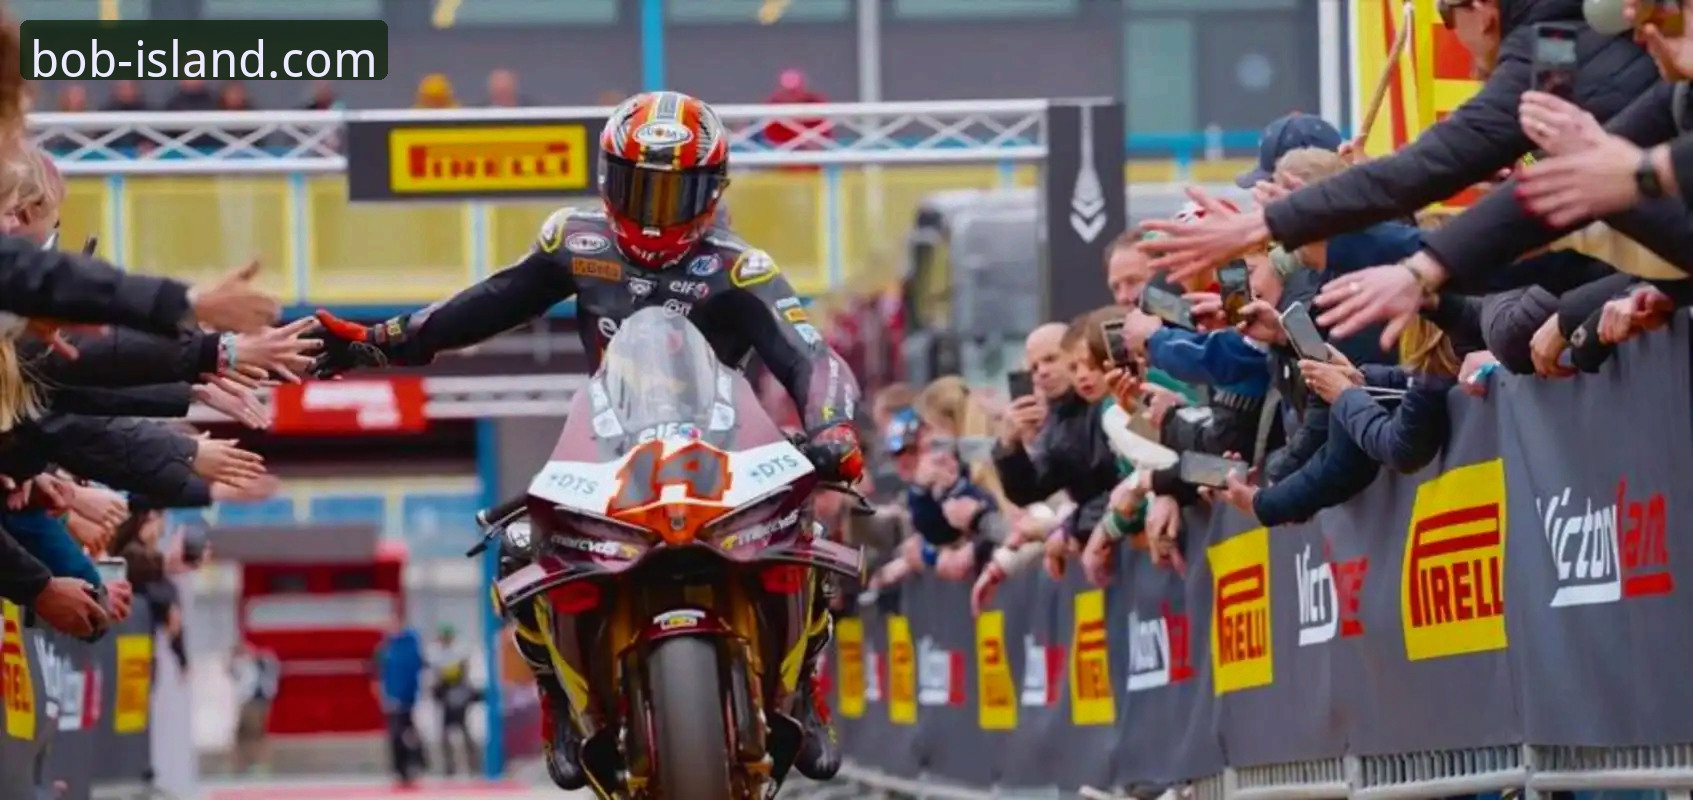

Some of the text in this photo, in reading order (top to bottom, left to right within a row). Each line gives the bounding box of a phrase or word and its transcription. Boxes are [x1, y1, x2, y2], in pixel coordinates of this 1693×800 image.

[408, 141, 570, 178] PIRELLI
[758, 454, 799, 479] DTS
[563, 473, 600, 496] DTS
